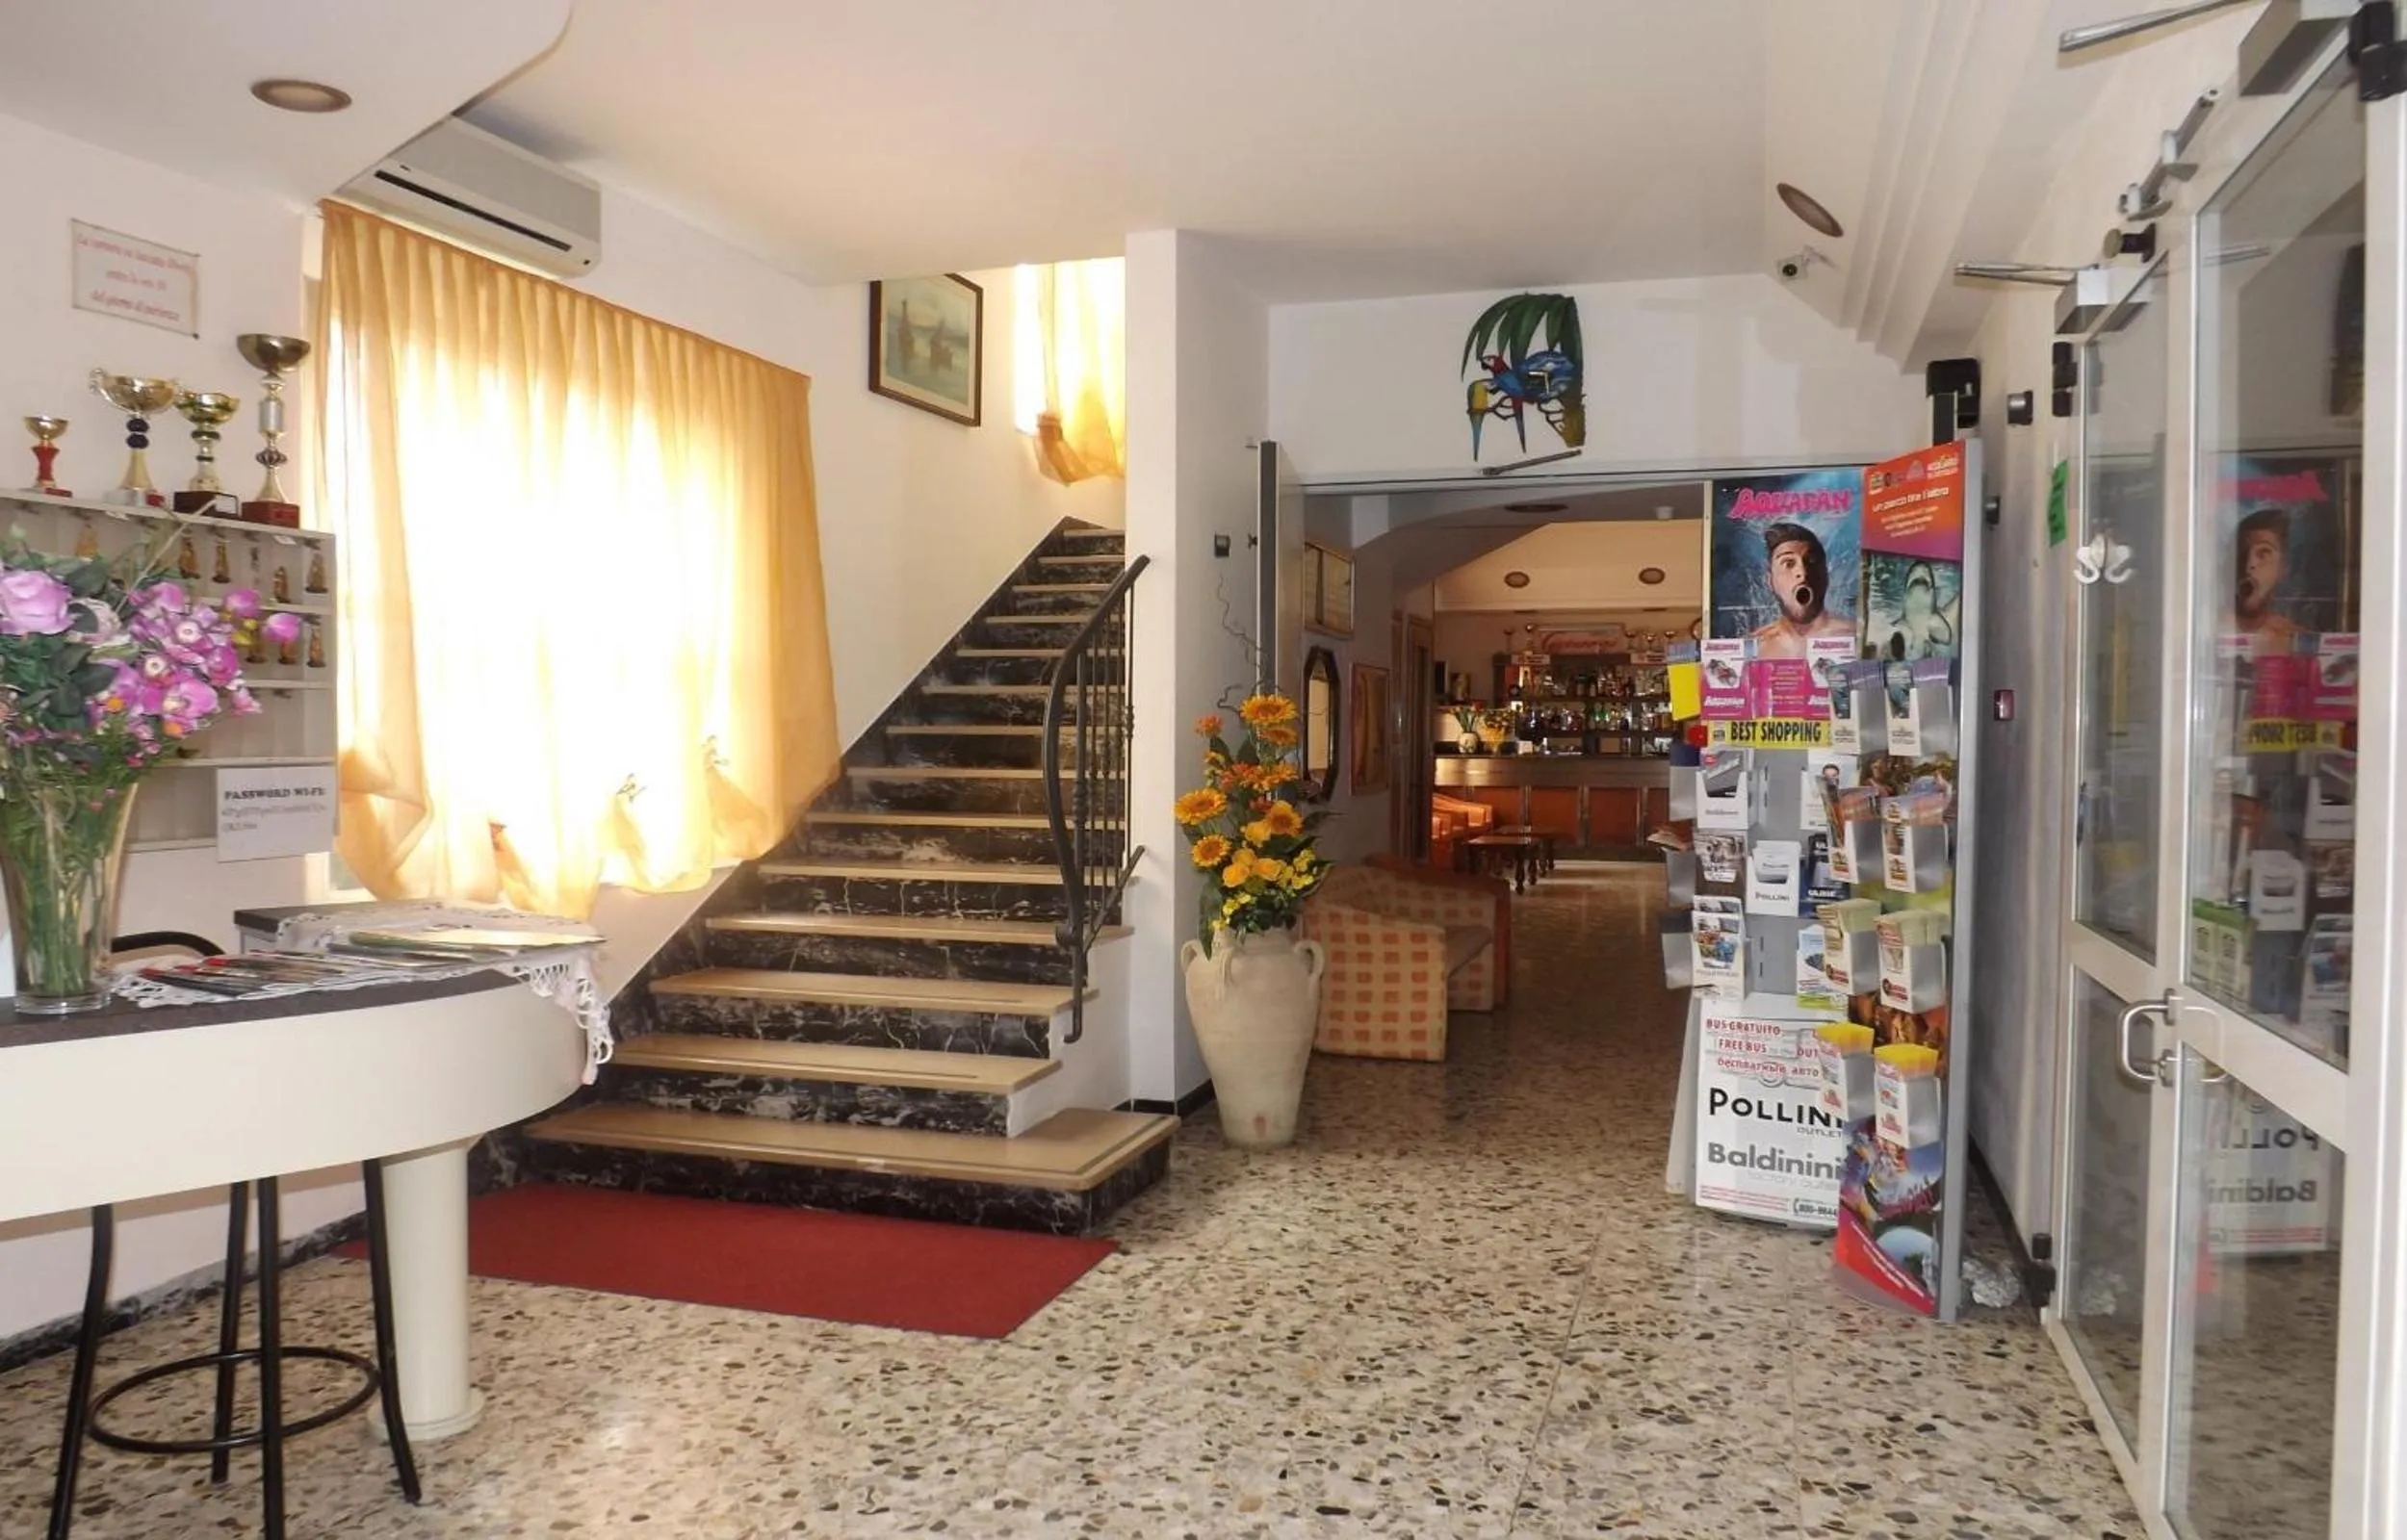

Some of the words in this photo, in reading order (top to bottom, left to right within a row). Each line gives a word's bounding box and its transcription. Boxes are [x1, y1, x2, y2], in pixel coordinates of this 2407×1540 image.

[1726, 487, 1852, 520] AQUAFAN
[1730, 721, 1756, 741] BEST
[1760, 721, 1823, 743] SHOPPING
[224, 788, 291, 801] PASSWORD
[1706, 1018, 1726, 1030] BUS
[1728, 1020, 1781, 1036] GRATUITO
[1719, 1039, 1745, 1051] FREE
[1746, 1041, 1767, 1054] BUS
[1709, 1087, 1843, 1129] POLLINI
[1708, 1142, 1843, 1180] Baldinini
